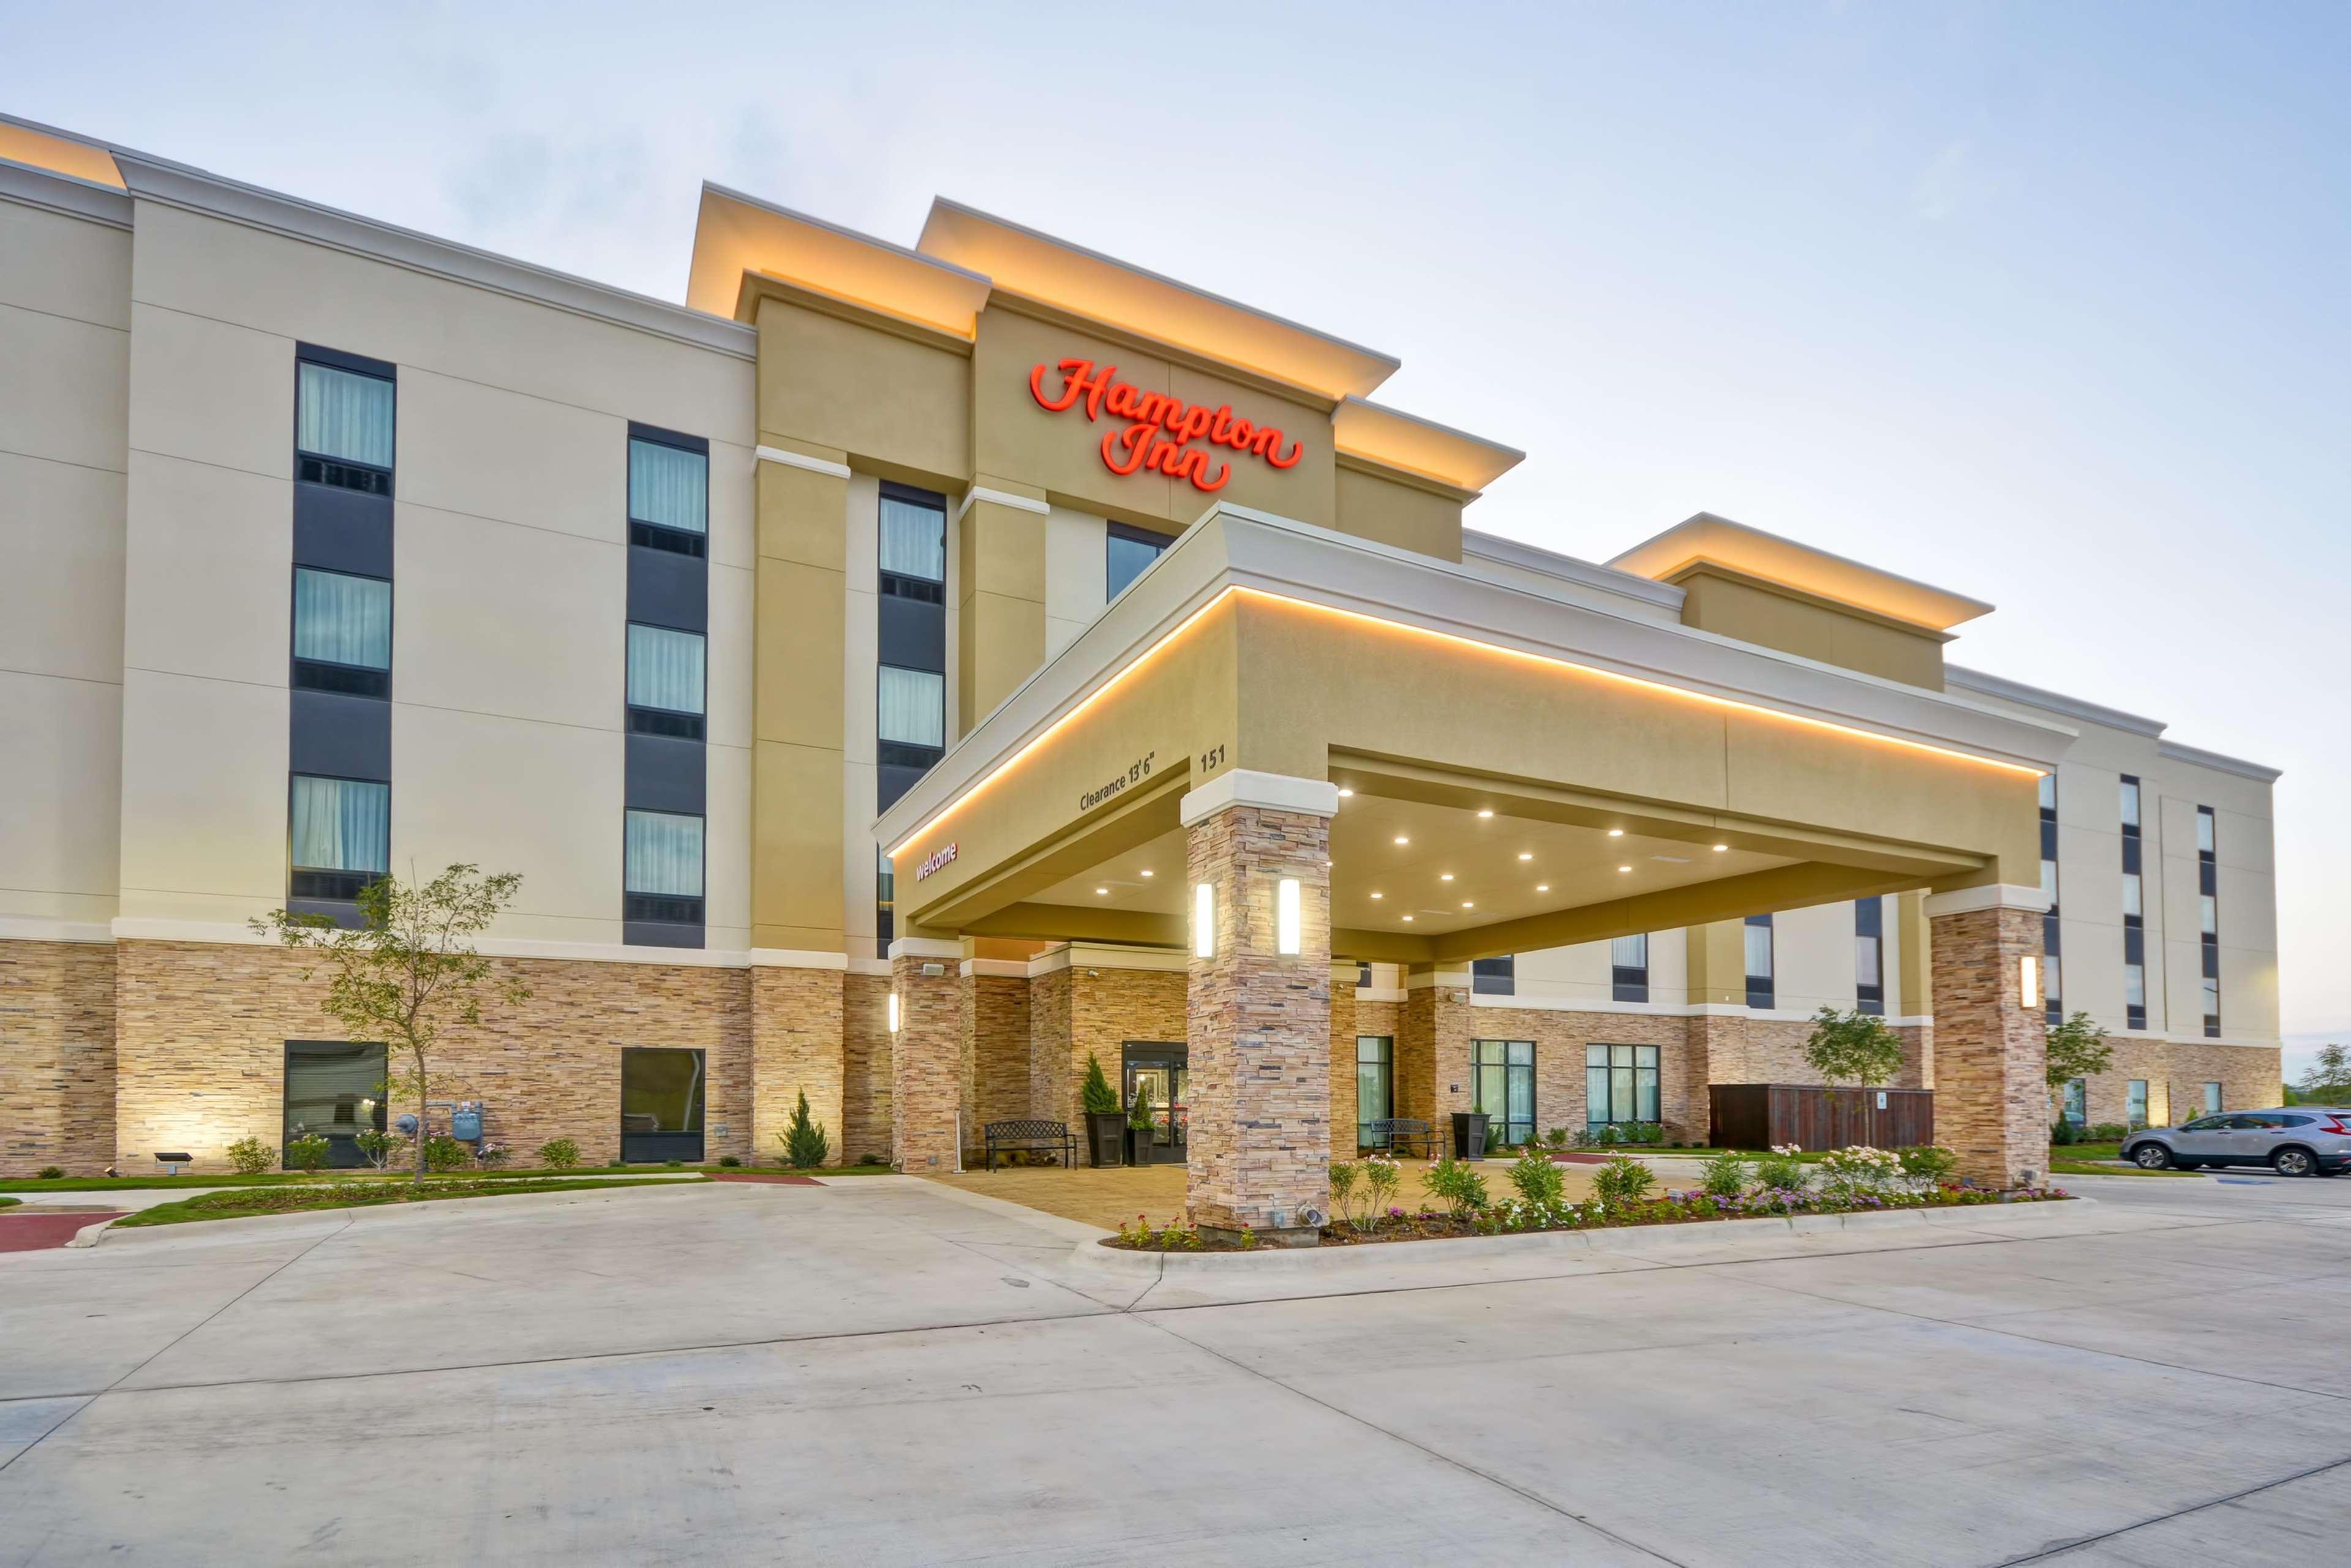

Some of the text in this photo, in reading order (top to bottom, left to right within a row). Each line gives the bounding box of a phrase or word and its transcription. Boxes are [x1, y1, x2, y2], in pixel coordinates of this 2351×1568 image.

[1030, 358, 1303, 469] Hampton
[1101, 424, 1231, 492] Inn
[1201, 744, 1225, 773] 151
[1080, 775, 1126, 811] Clearance
[916, 842, 958, 882] welcome
